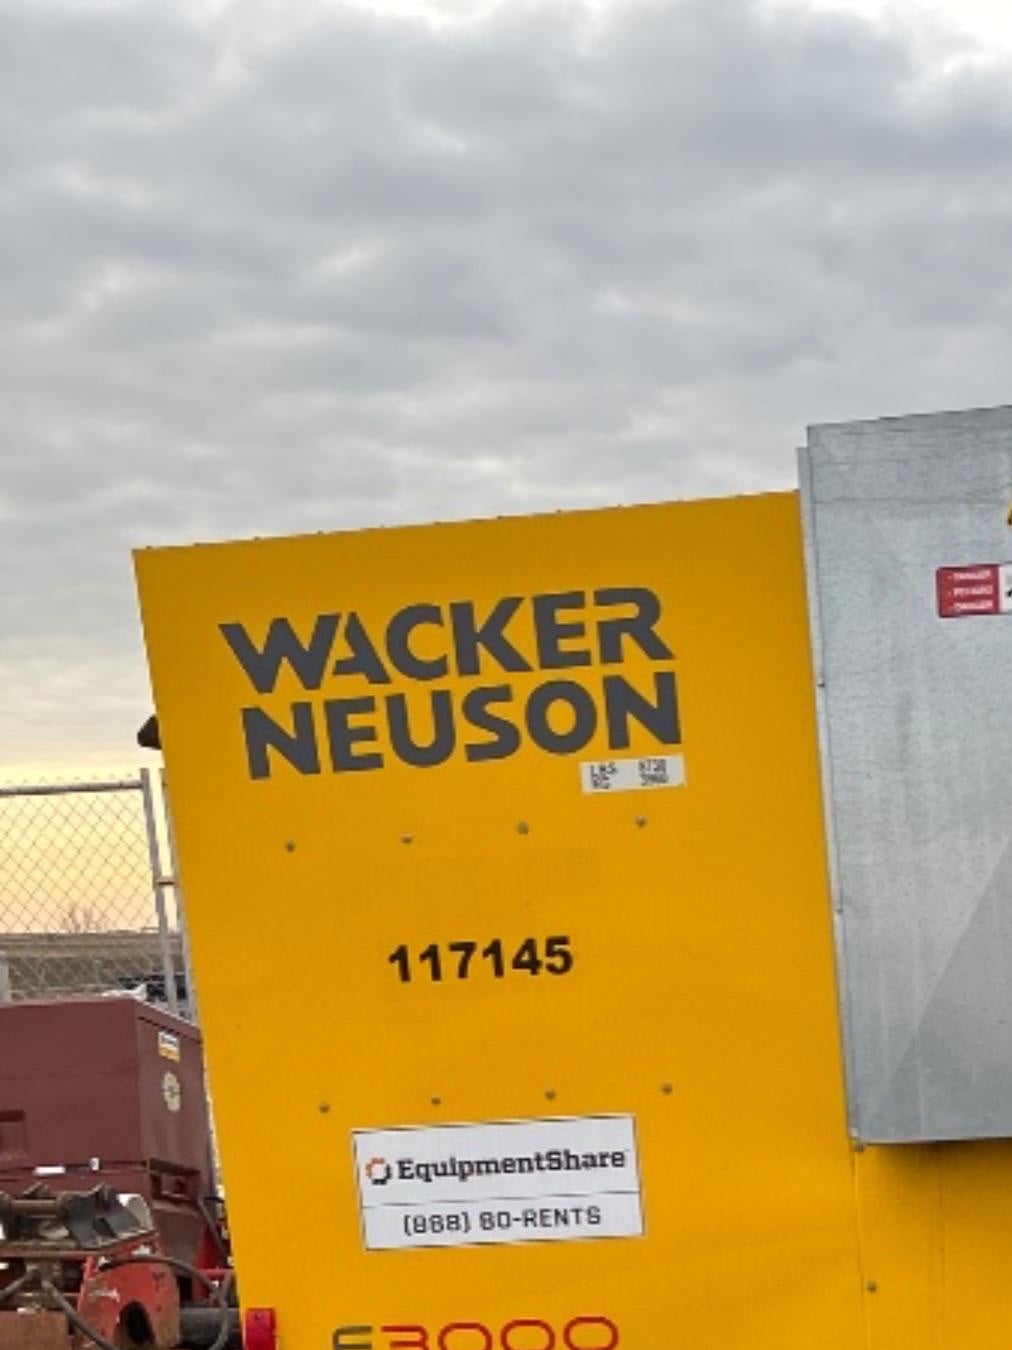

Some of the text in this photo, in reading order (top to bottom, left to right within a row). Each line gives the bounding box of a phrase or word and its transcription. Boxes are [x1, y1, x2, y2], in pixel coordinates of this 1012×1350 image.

[217, 586, 675, 695] WACKER
[240, 670, 682, 781] NEUSON
[388, 935, 574, 983] 117145
[397, 1148, 626, 1183] EquipmentShare
